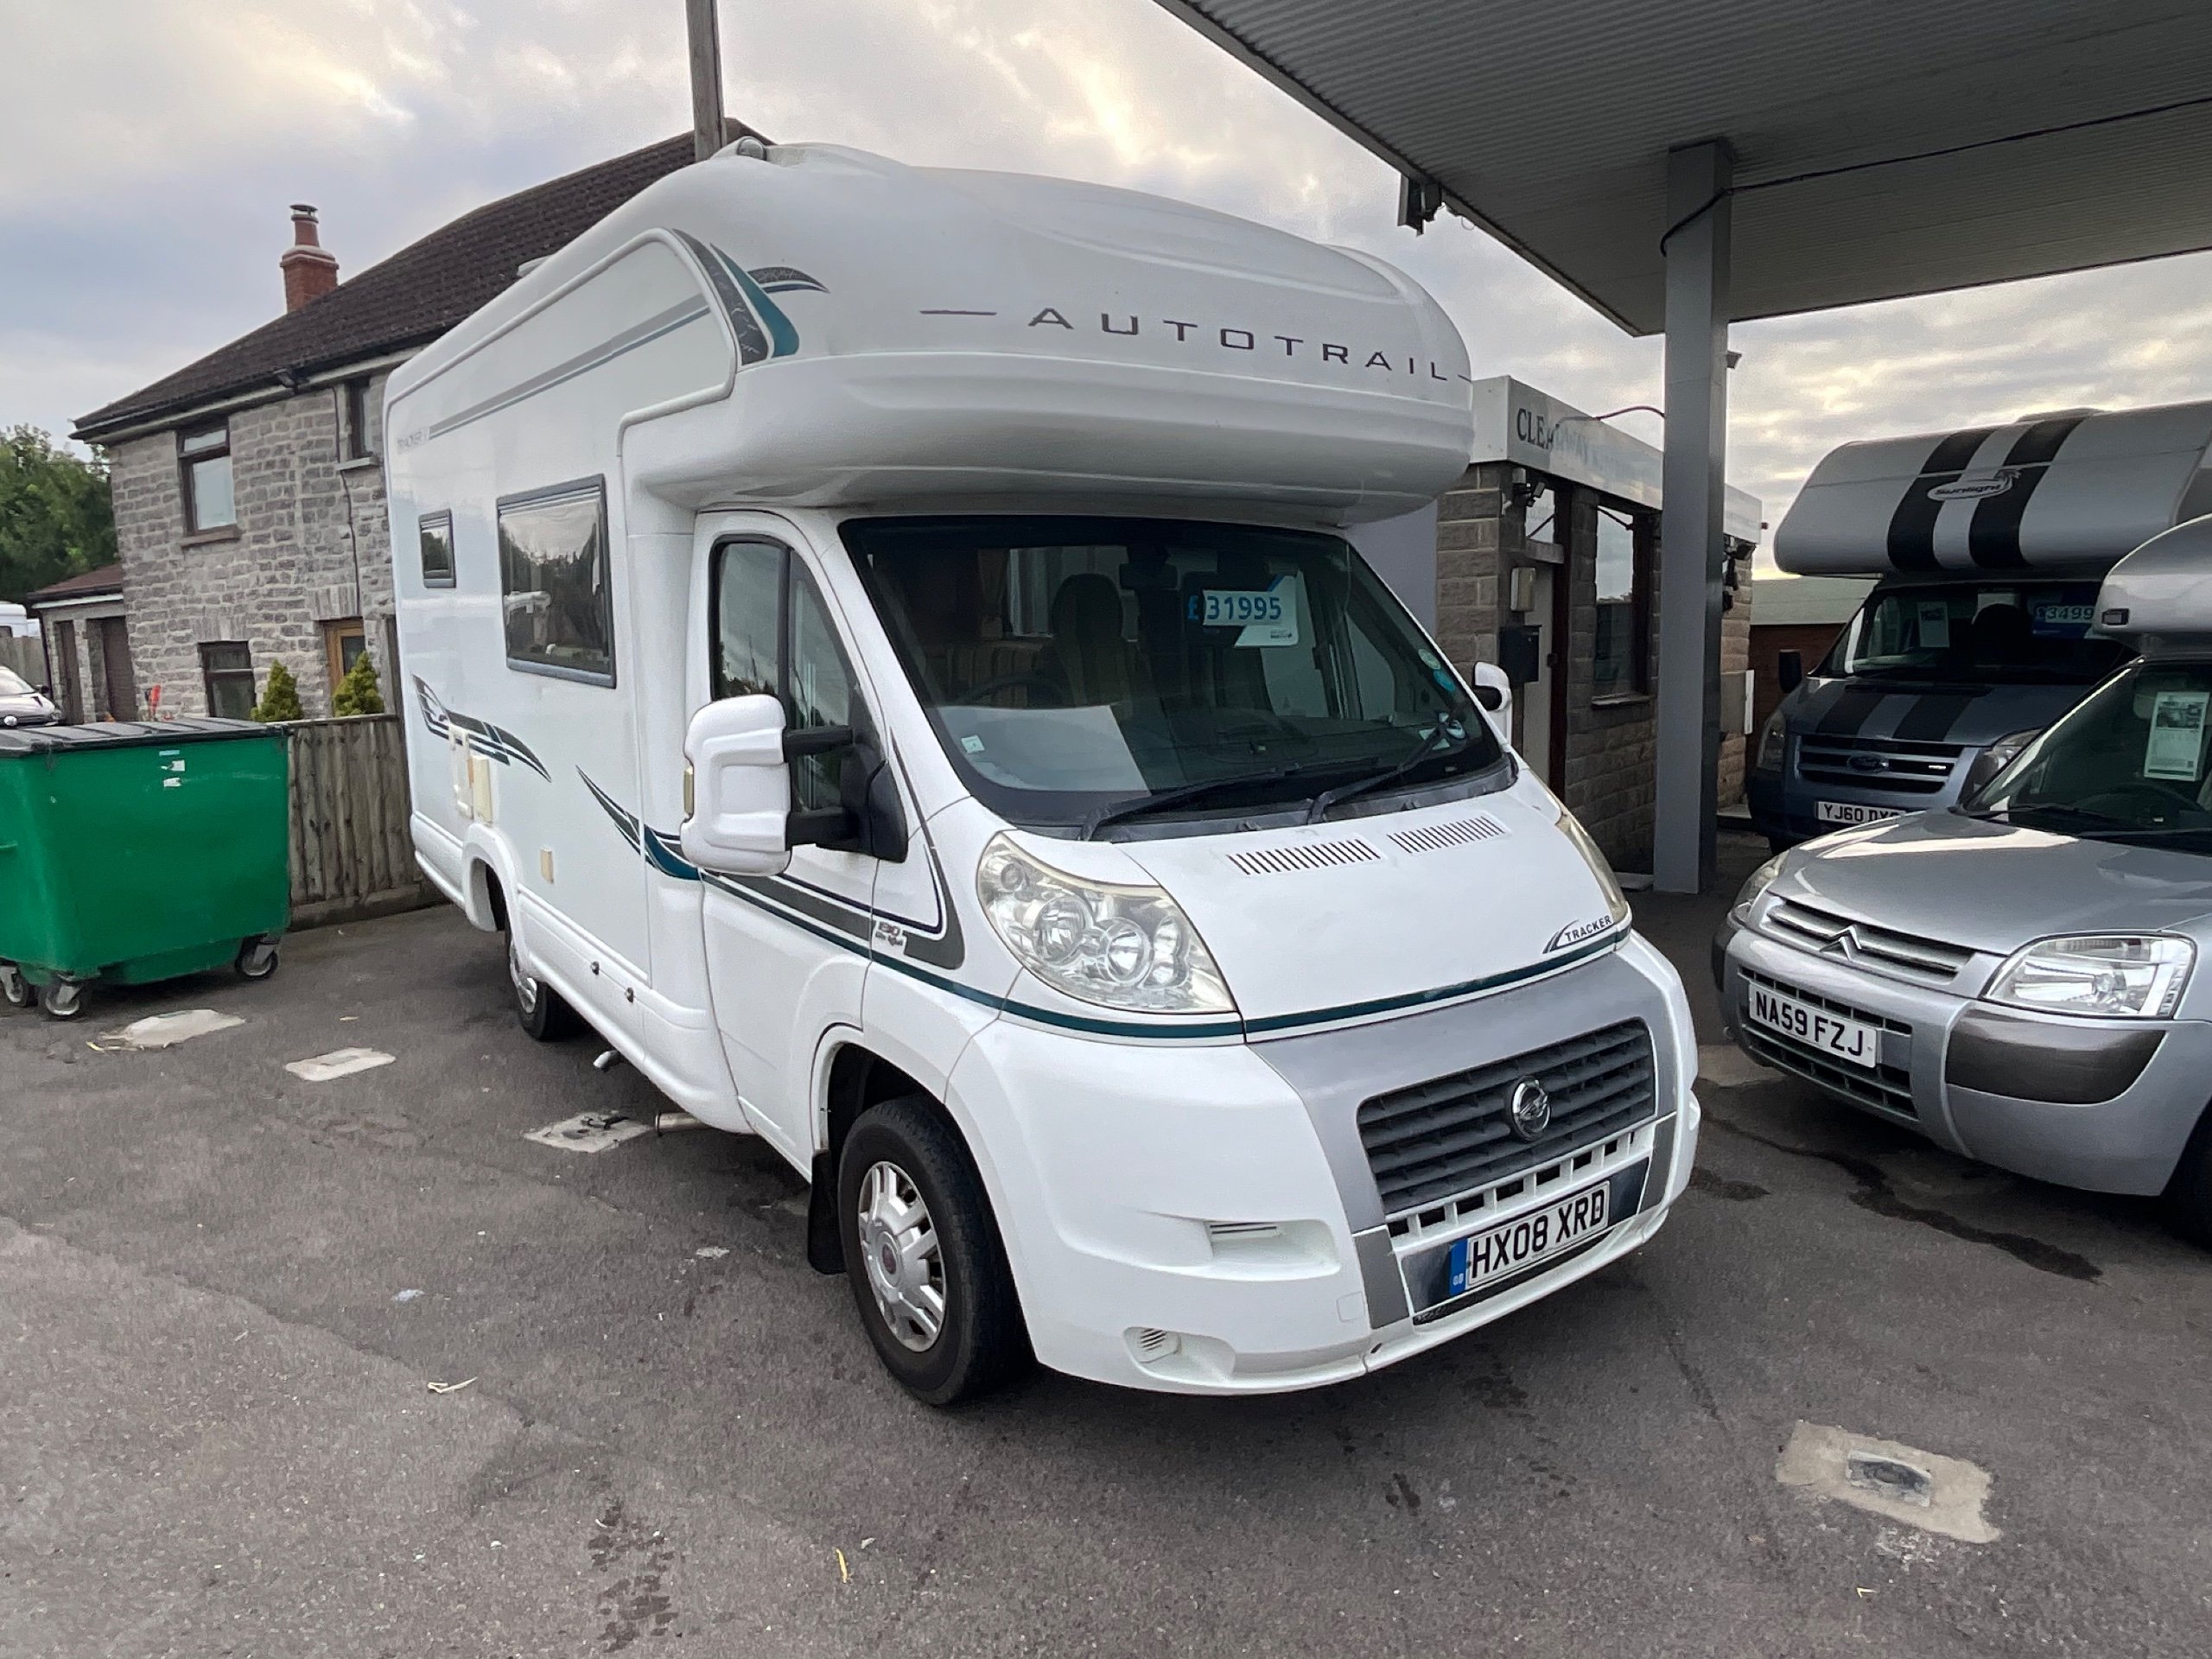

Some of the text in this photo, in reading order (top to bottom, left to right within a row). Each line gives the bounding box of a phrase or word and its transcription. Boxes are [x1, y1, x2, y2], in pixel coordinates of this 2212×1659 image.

[1027, 308, 1448, 382] AUTOTRAIL
[1824, 804, 1865, 822] YJ60
[1565, 915, 1612, 942] TRACKER
[1756, 991, 1864, 1057] NA59 FZJ
[1471, 1189, 1605, 1279] HX08 XRD
